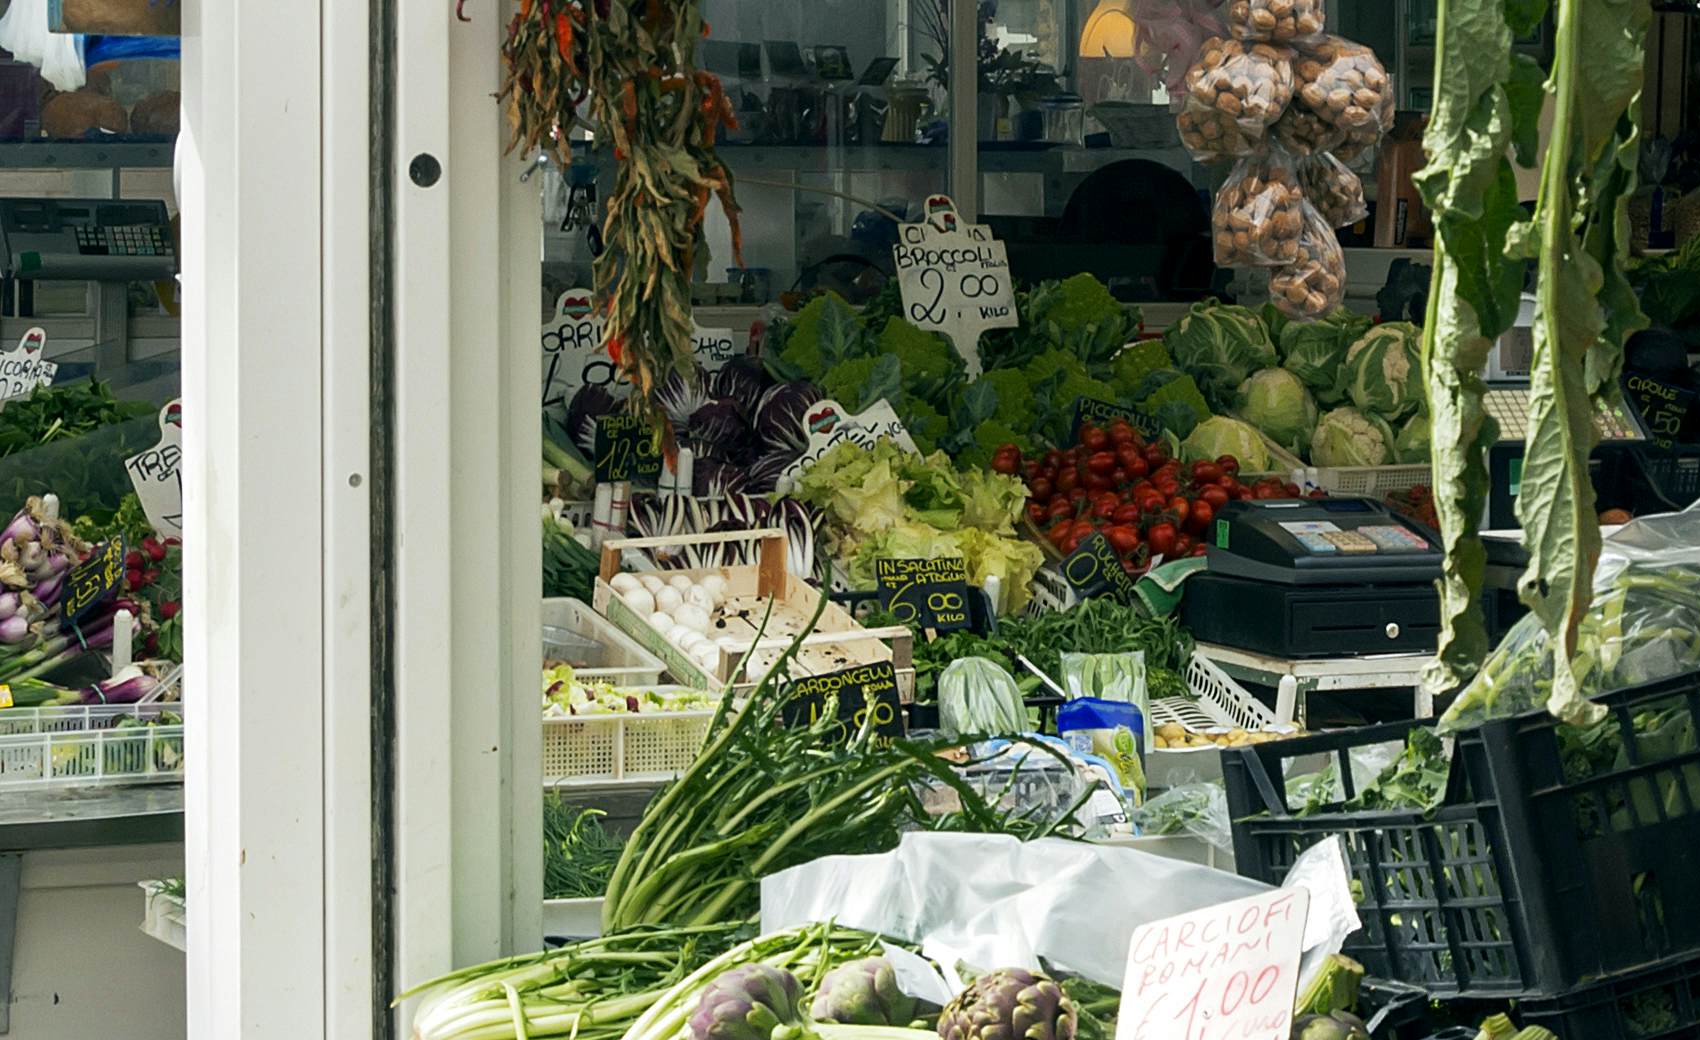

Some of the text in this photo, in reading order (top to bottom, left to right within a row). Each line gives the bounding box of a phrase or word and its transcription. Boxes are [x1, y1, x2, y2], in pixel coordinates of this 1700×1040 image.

[894, 244, 993, 269] BROCCOLI
[979, 306, 1010, 319] KILO
[542, 321, 602, 352] ORRI
[936, 612, 965, 624] KILO
[1132, 893, 1296, 965] CARCIOFI
[1138, 931, 1273, 998] ROMANI
